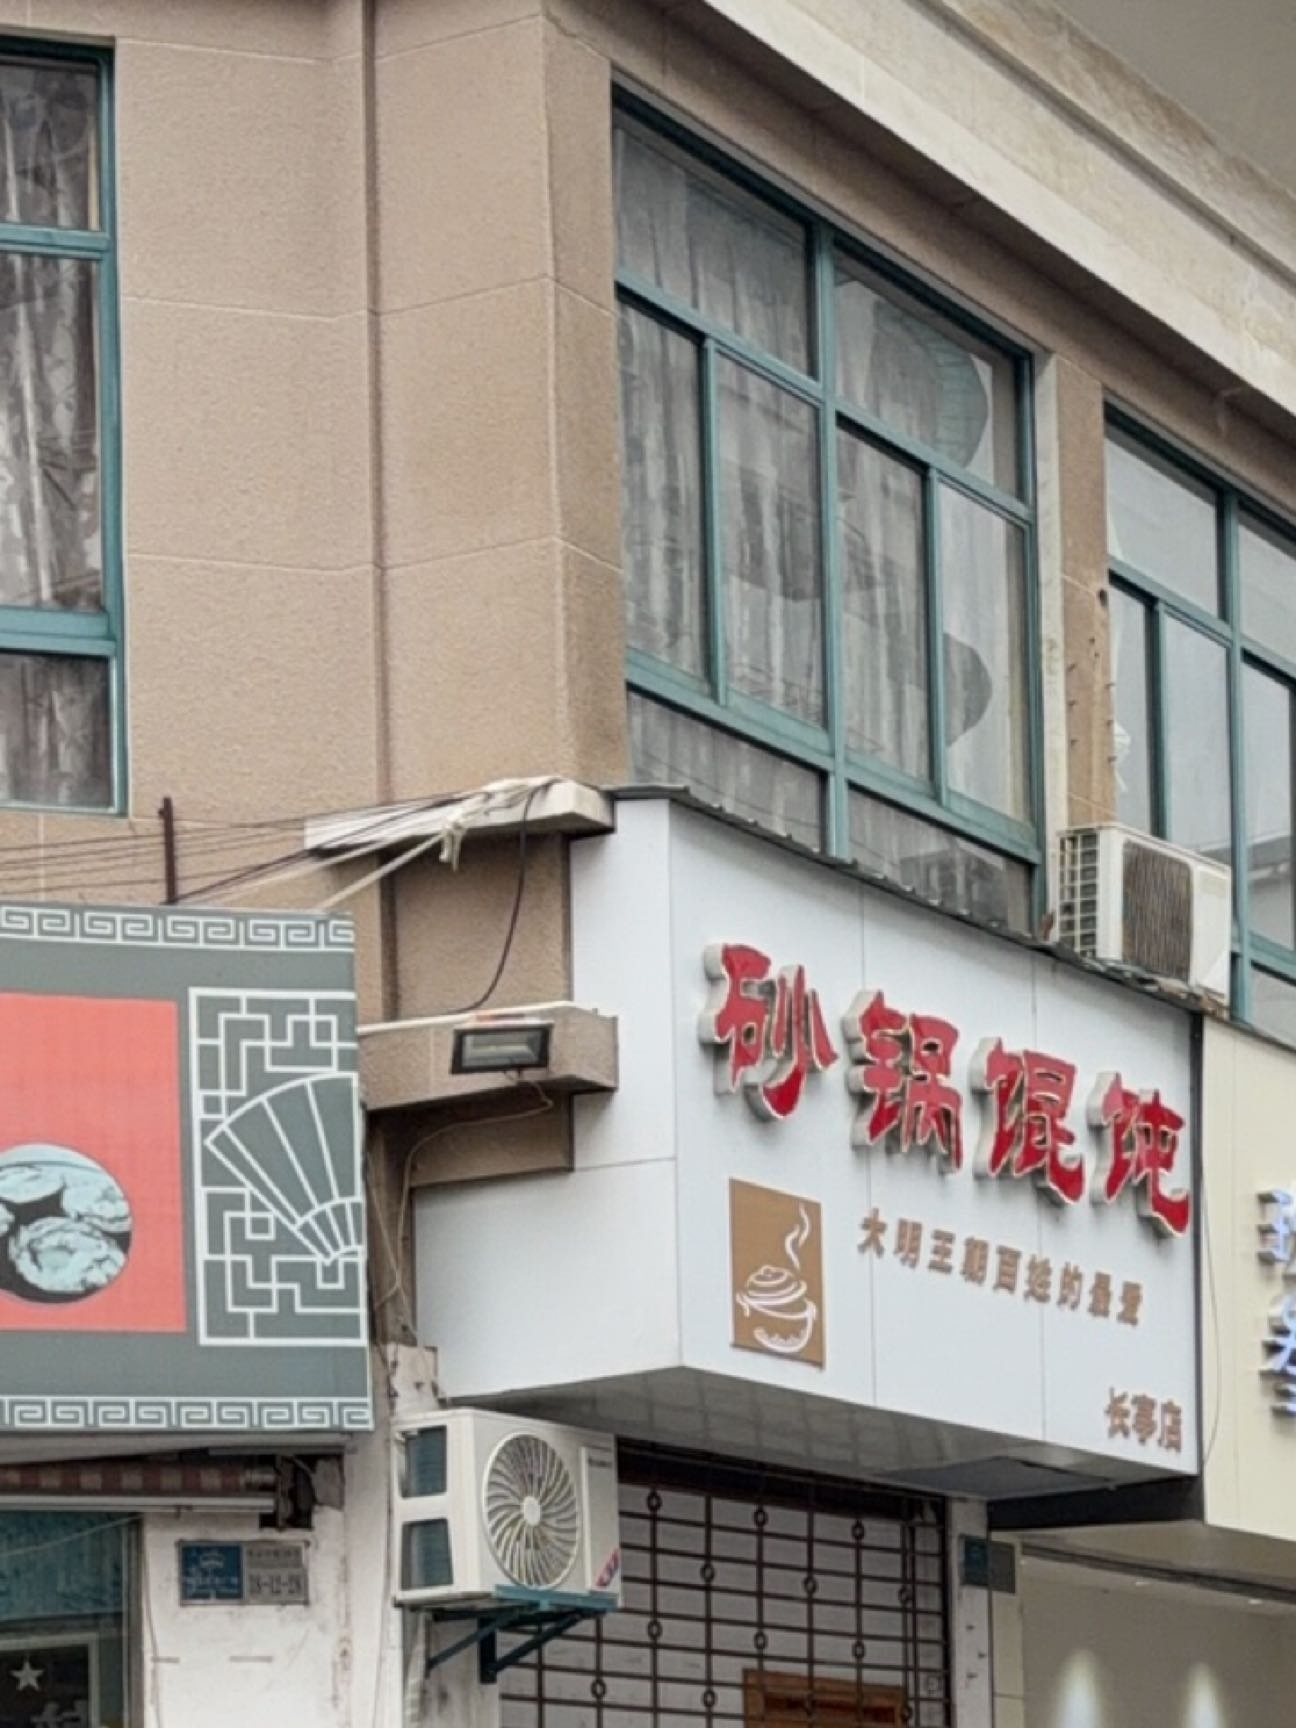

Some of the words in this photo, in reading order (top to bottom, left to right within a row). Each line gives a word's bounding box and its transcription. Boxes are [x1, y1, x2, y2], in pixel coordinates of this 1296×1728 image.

[700, 944, 1190, 1238] 砂锅馄饨
[1104, 1387, 1182, 1452] 长亭店
